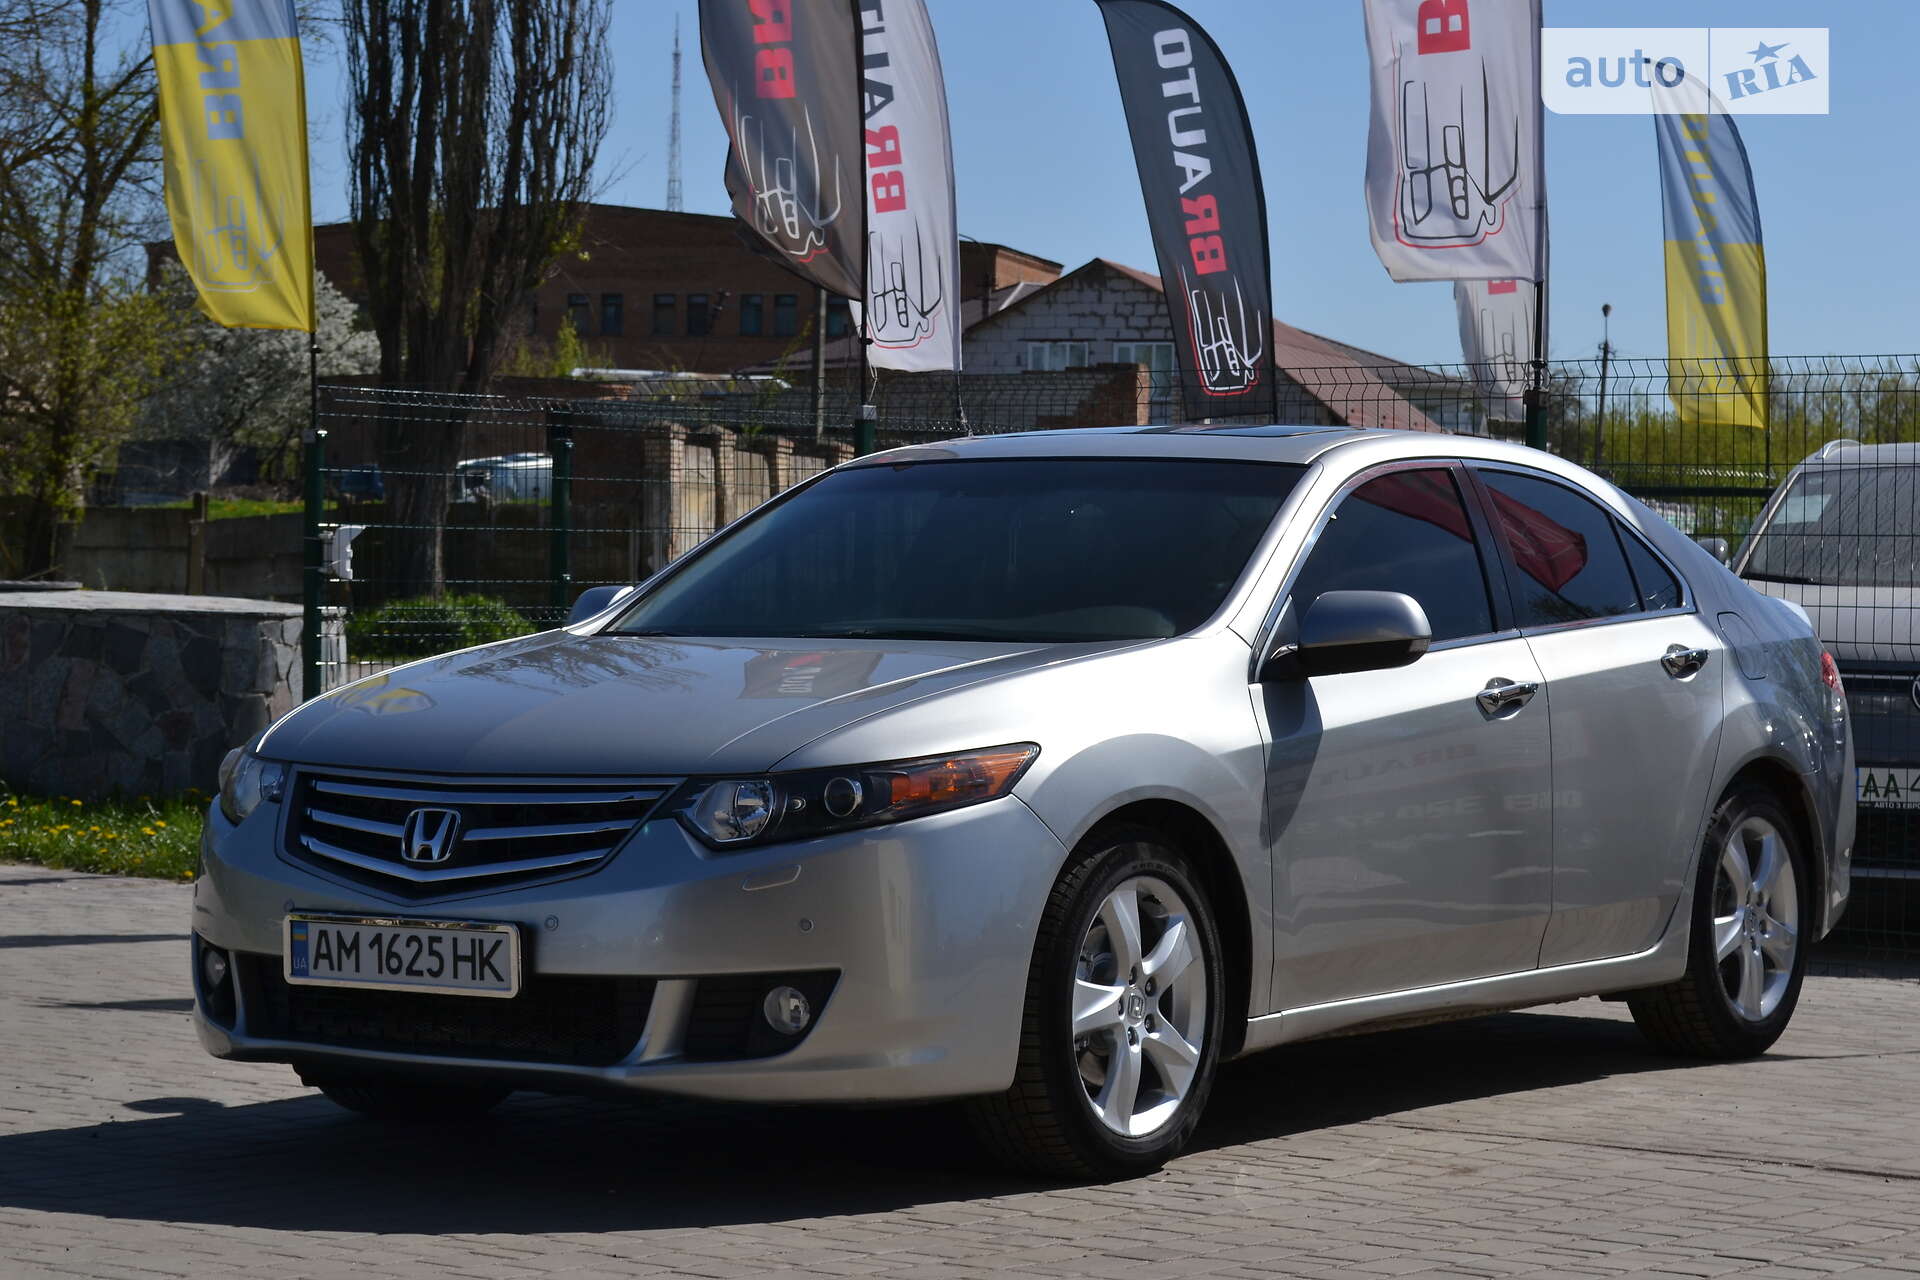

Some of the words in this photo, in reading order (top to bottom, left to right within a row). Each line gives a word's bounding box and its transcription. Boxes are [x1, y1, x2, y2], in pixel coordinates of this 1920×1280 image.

[312, 929, 361, 973] AM
[368, 932, 445, 978] 1625
[452, 936, 505, 982] HK
